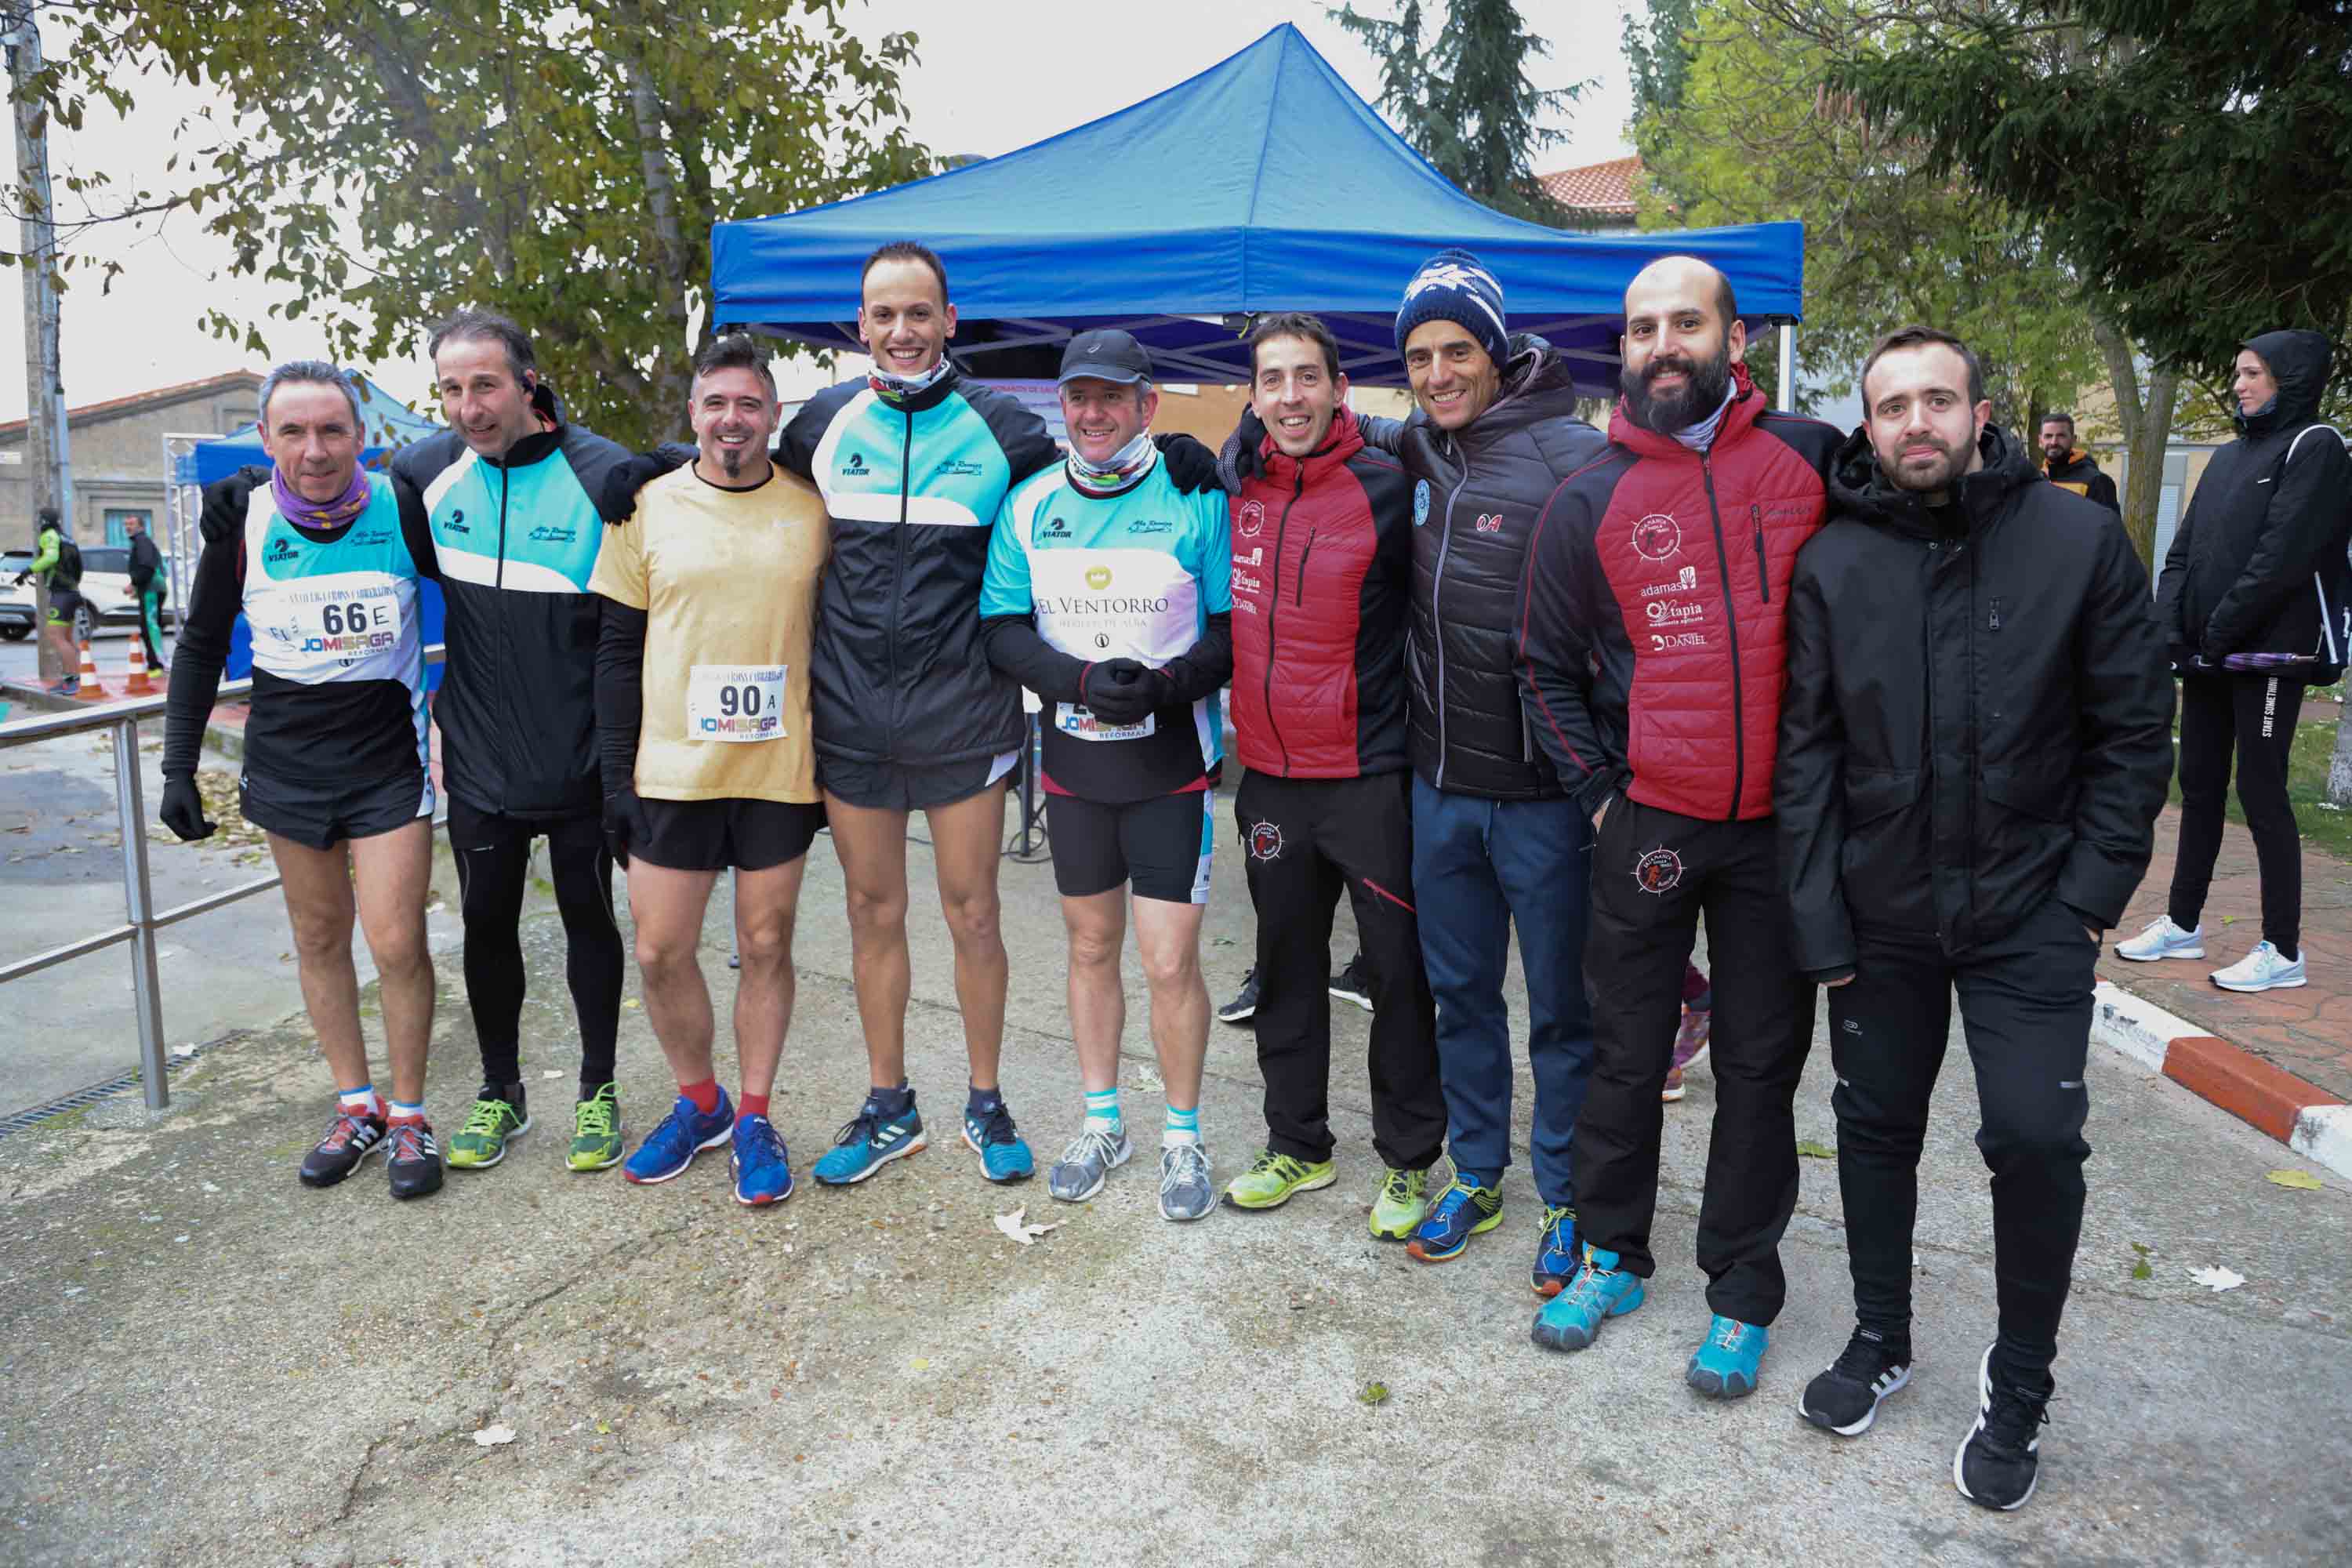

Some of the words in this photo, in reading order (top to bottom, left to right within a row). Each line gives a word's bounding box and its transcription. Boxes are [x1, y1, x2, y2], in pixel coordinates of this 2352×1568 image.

[268, 550, 299, 562] VIATOR
[1640, 582, 1682, 597] adamas
[1038, 598, 1055, 615] EL
[1059, 597, 1169, 615] VENTORRO
[322, 602, 367, 636] 66
[373, 605, 390, 626] E
[300, 631, 394, 653] JOMISAGA
[1665, 633, 1708, 648] DANIEL
[720, 684, 760, 717] 90
[767, 694, 776, 710] A
[1099, 731, 1146, 739] REFORMAS
[2262, 715, 2274, 738] START
